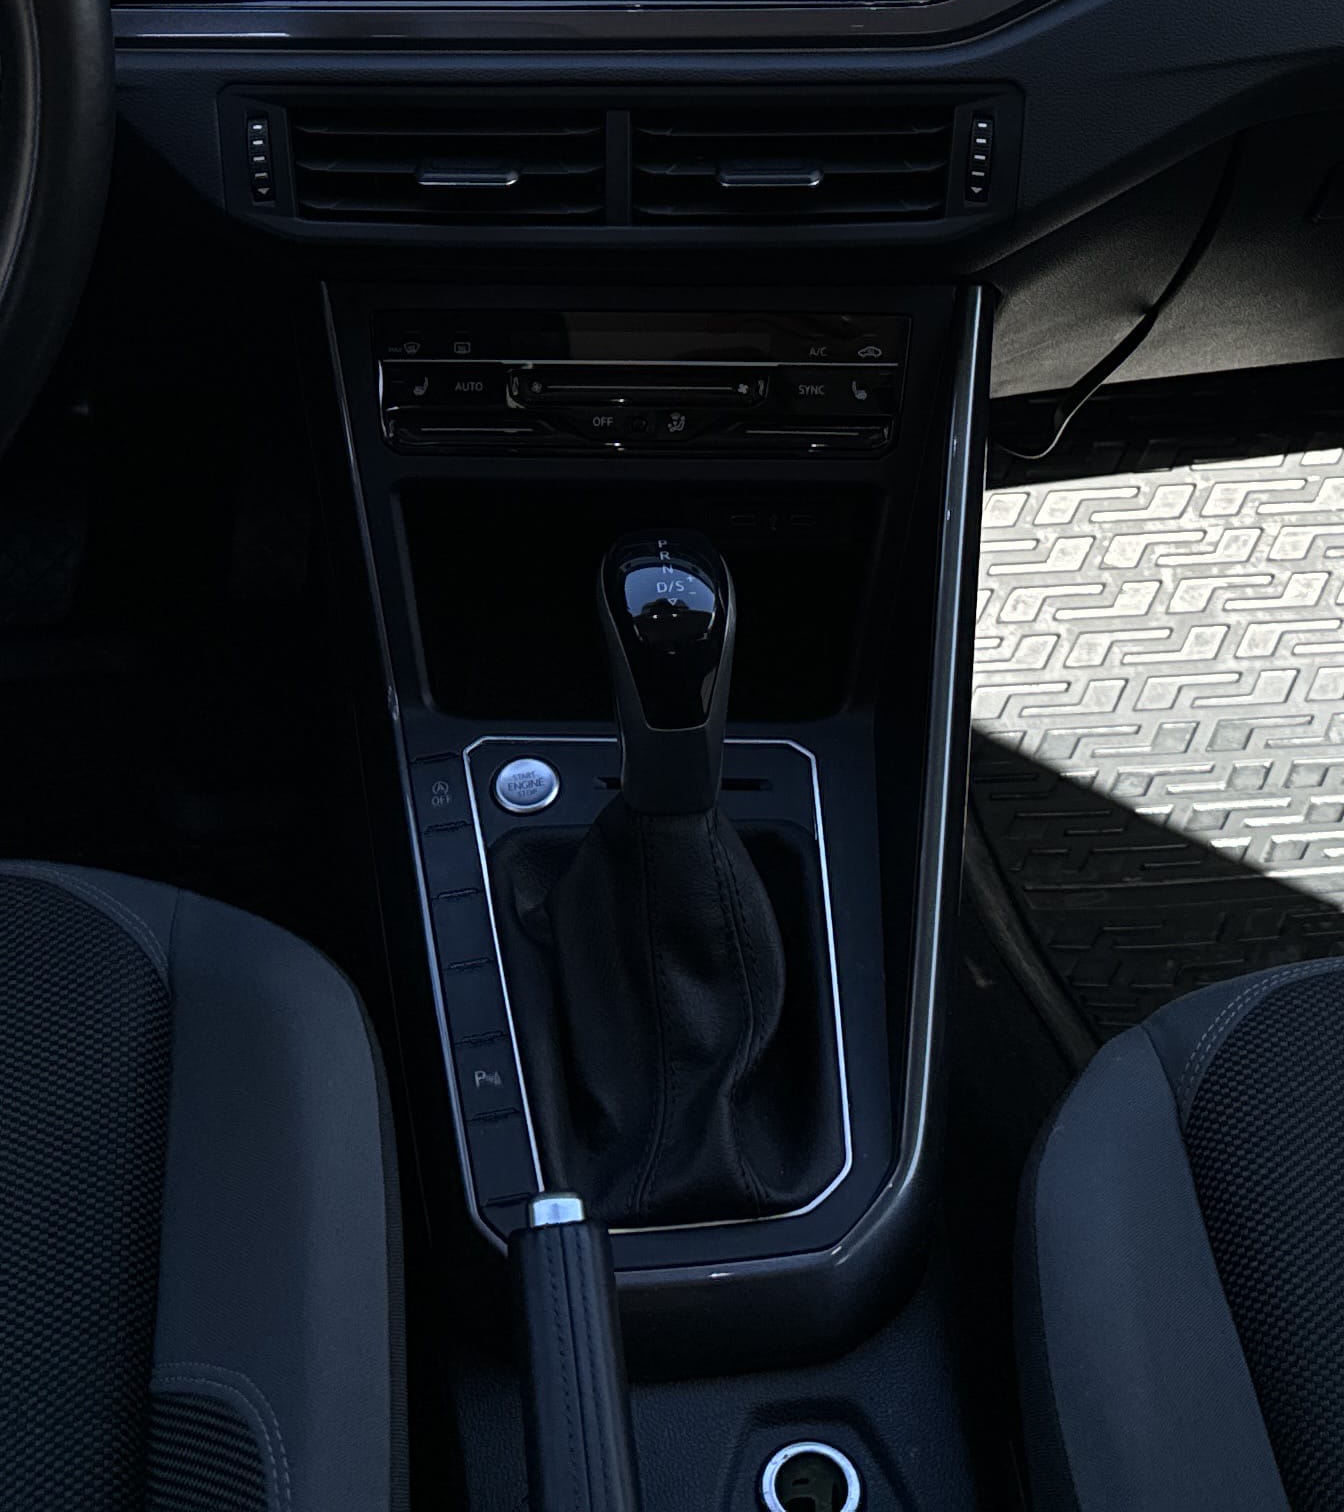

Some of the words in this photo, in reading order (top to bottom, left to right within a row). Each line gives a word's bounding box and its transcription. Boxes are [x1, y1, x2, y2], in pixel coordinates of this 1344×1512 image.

[807, 345, 828, 358] A/C
[454, 381, 484, 393] AUTO
[797, 383, 825, 396] SYNC
[592, 416, 614, 428] OFF
[657, 539, 668, 549] P
[659, 551, 671, 561] R
[662, 564, 674, 575] N
[656, 580, 685, 594] D/S
[512, 770, 536, 781] START
[507, 777, 545, 792] ENGINE
[431, 794, 451, 807] OFF
